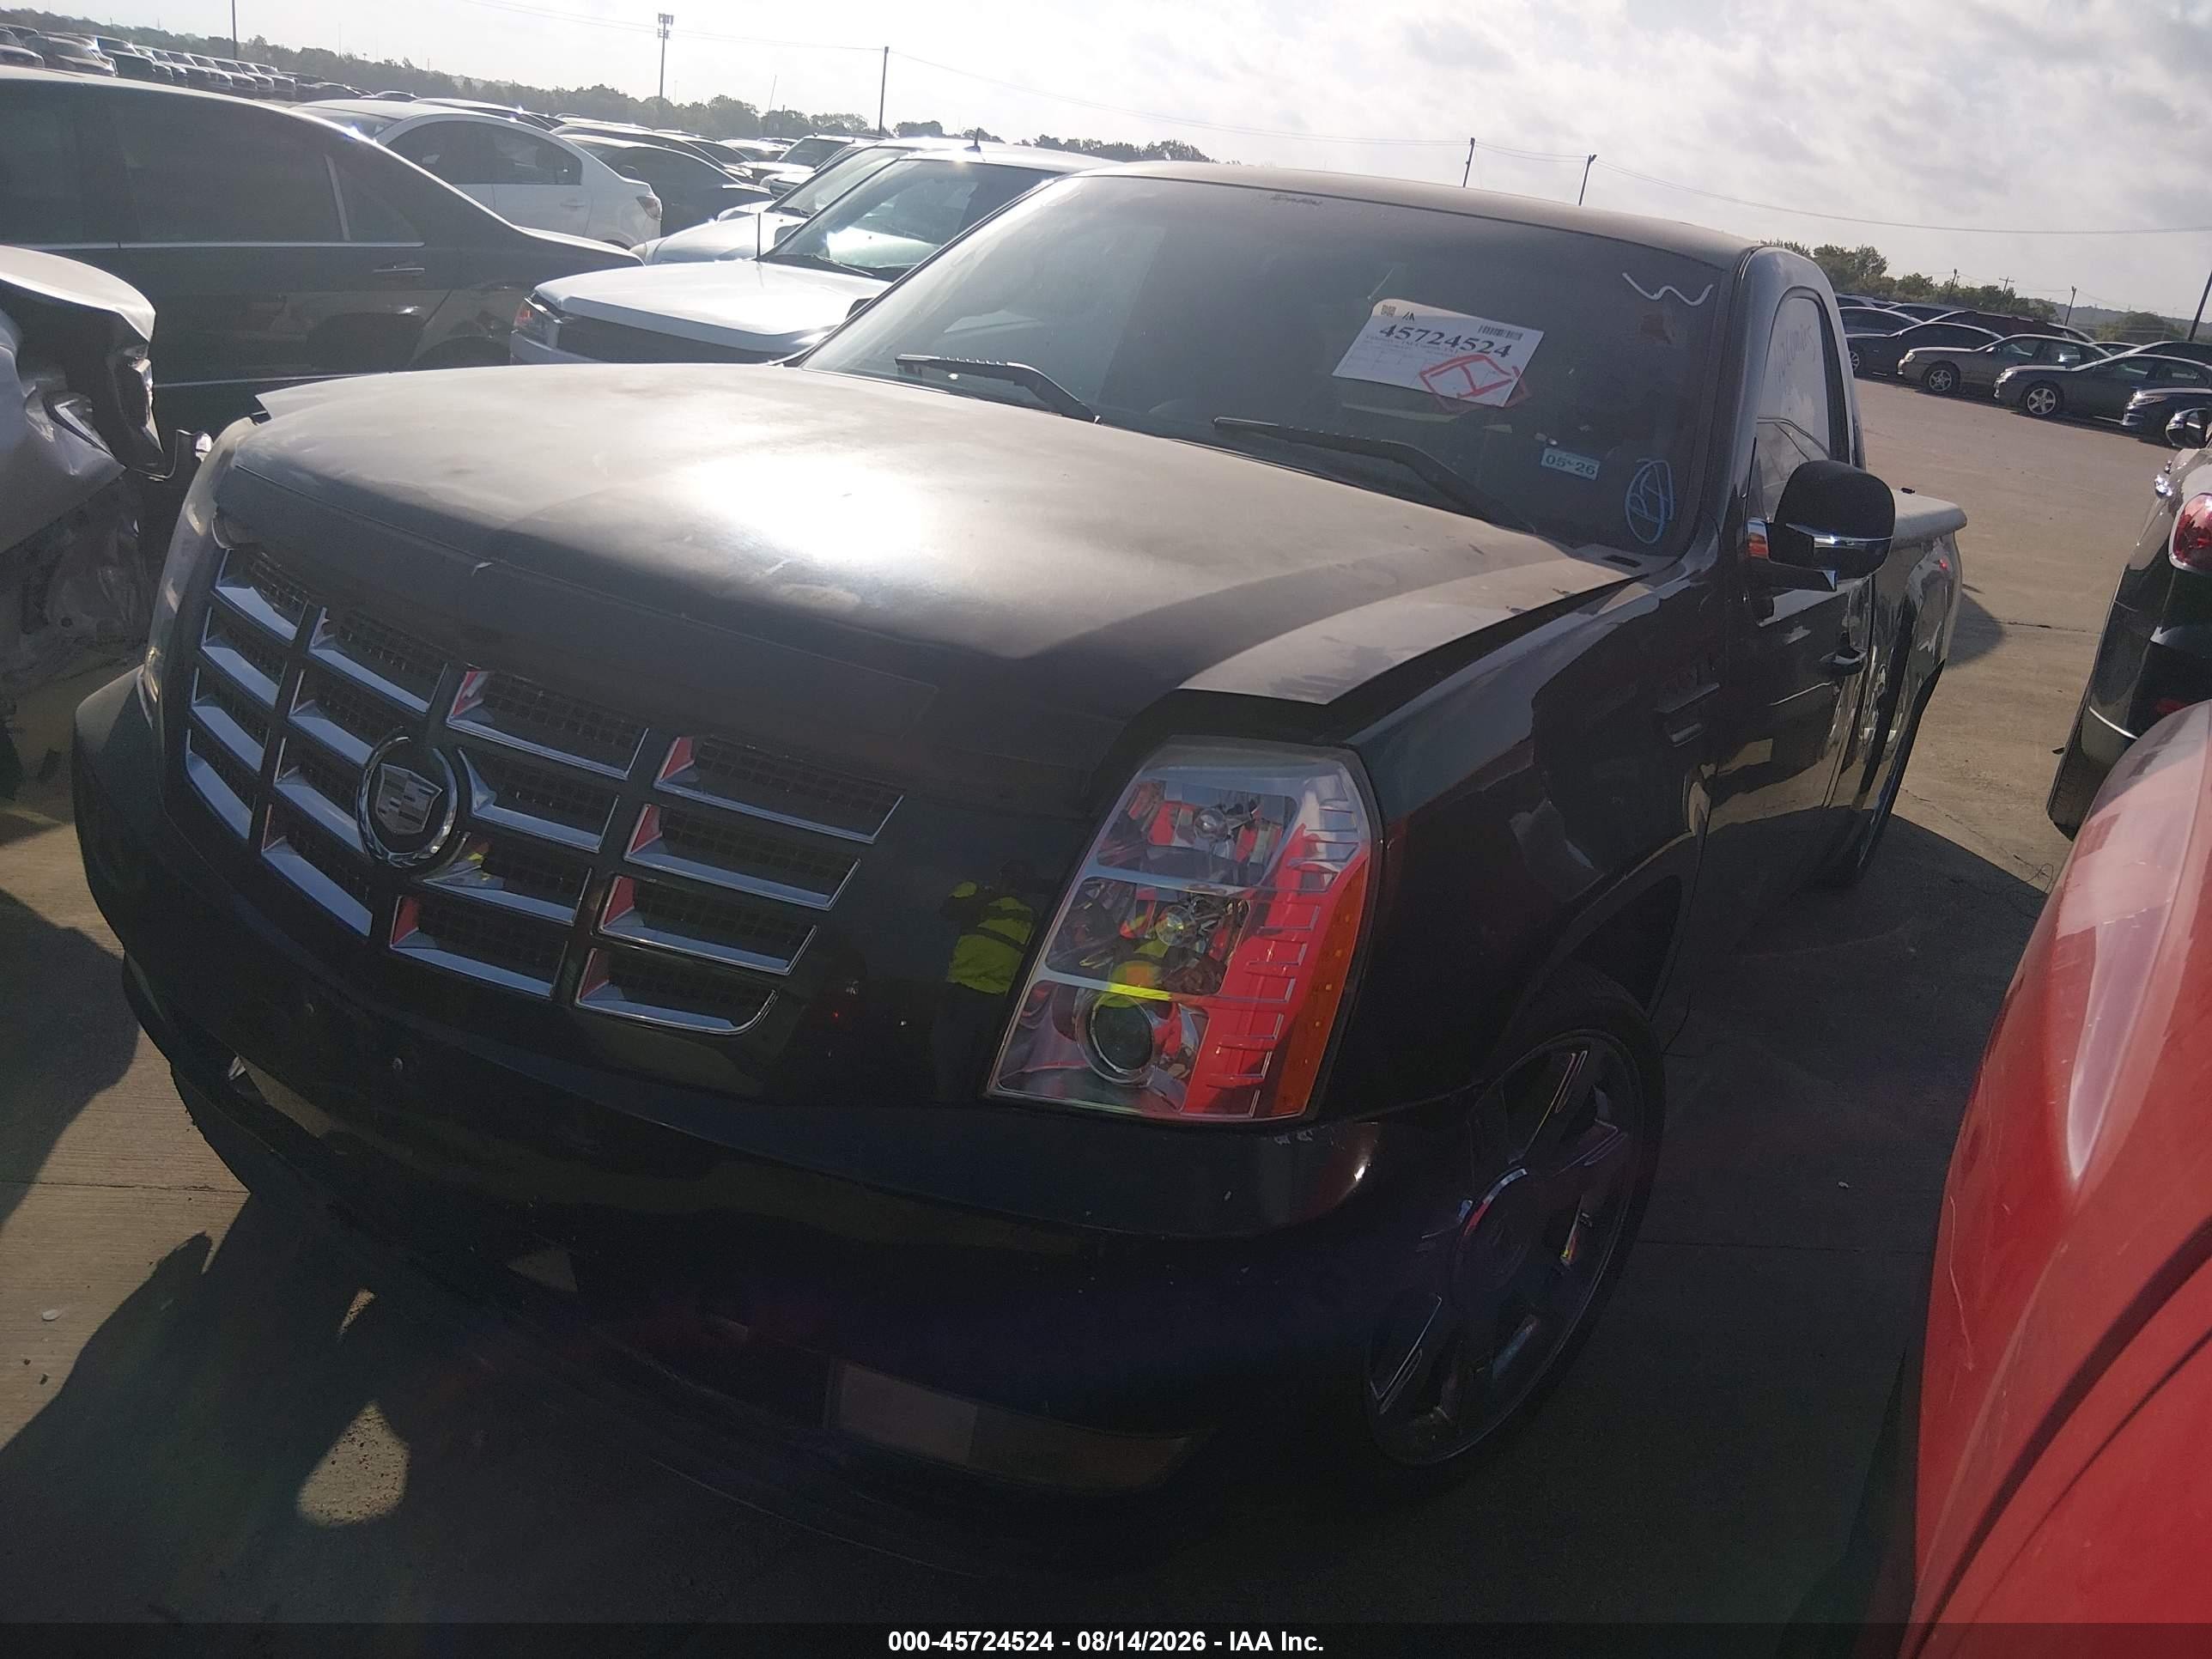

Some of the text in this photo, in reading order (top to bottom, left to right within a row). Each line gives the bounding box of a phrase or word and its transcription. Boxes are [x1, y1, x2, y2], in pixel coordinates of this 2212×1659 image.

[1379, 324, 1512, 358] 45724524
[1545, 453, 1567, 468] 05
[1574, 461, 1596, 476] 26
